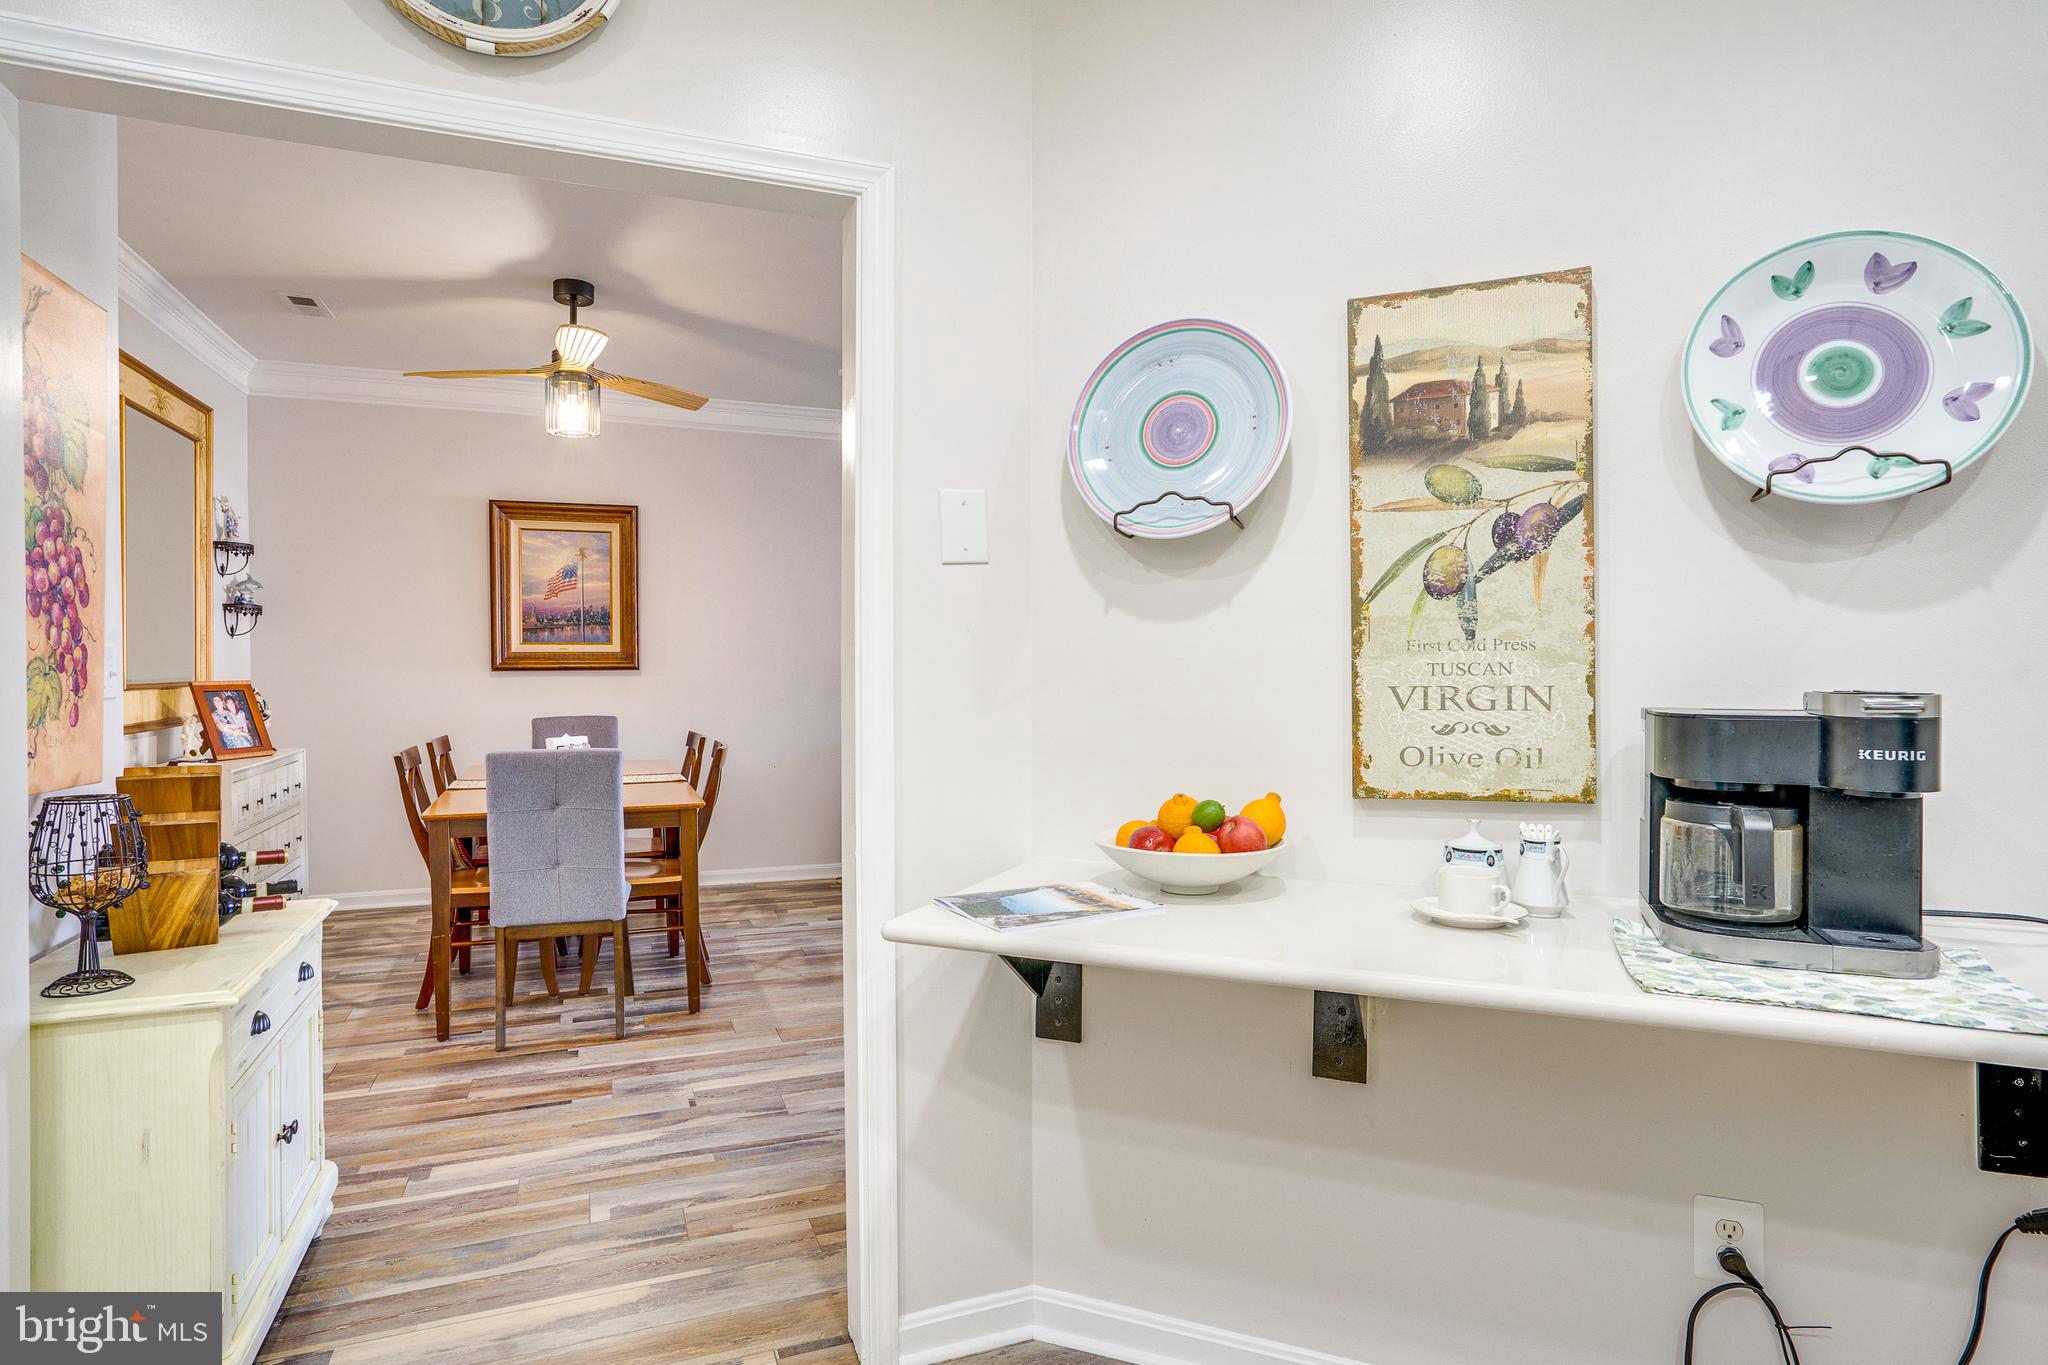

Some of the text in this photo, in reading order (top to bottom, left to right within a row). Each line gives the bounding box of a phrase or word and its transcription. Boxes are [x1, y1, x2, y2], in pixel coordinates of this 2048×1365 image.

[1406, 639, 1441, 652] First
[1493, 638, 1537, 651] Press
[1427, 662, 1513, 676] TUSCAN
[1387, 685, 1555, 712] VIRGIN
[1399, 746, 1543, 769] Olive Oil
[1858, 749, 1927, 762] KEURIG
